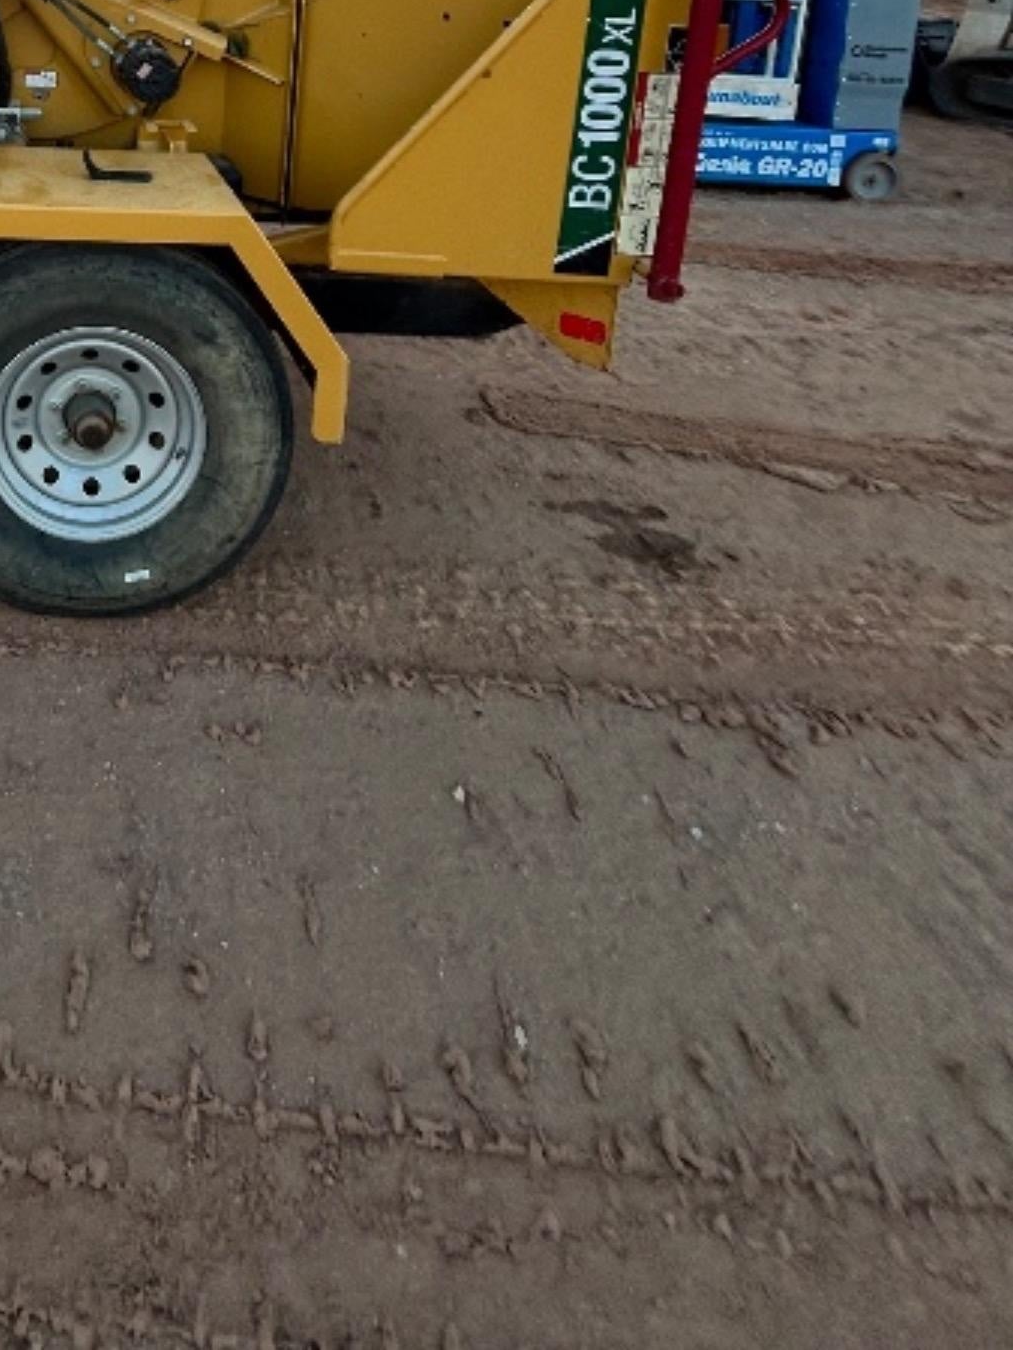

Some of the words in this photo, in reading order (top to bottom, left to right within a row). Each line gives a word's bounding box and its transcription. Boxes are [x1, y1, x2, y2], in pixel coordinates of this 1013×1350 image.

[601, 7, 637, 46] XL
[578, 47, 631, 147] 1000
[568, 155, 616, 211] BC
[758, 156, 828, 178] GR-20
